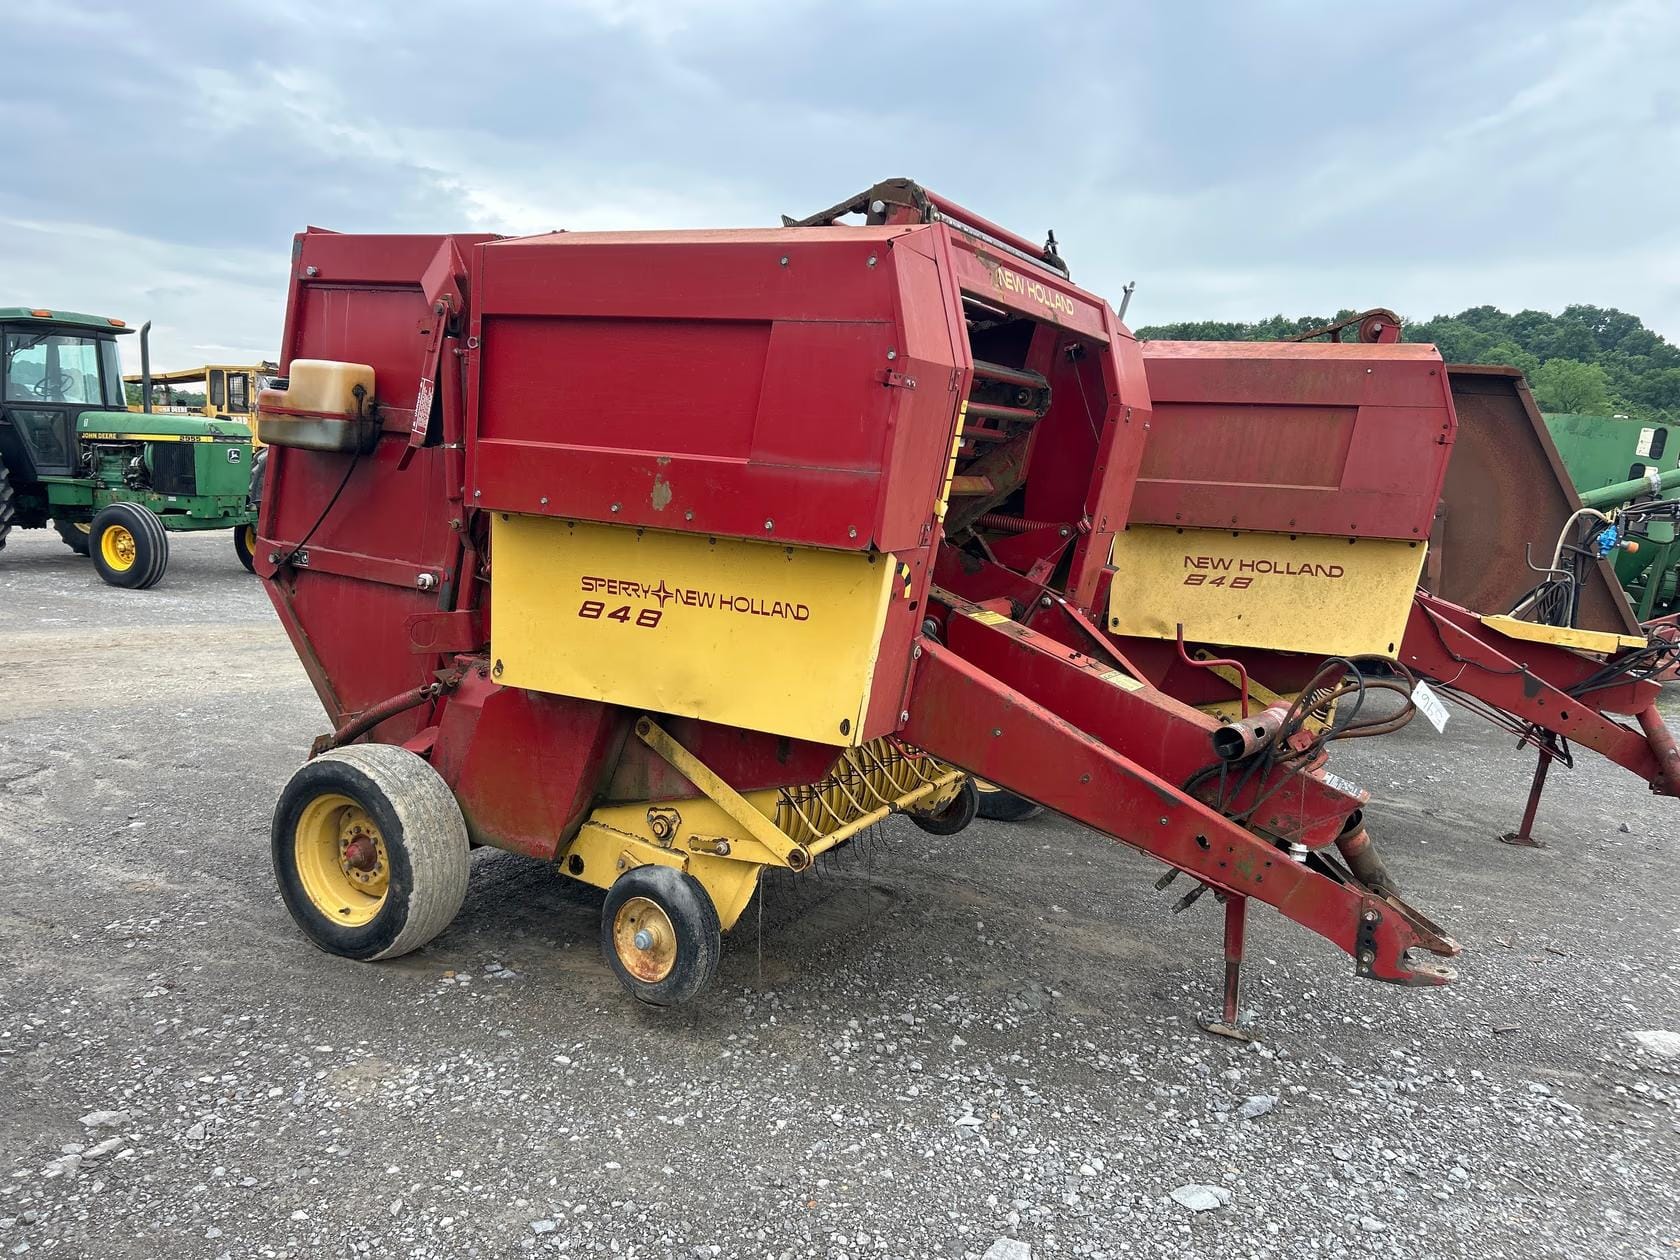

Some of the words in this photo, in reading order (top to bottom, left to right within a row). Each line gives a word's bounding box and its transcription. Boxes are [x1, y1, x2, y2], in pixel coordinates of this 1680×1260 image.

[997, 267, 1024, 294] NEW
[1027, 281, 1074, 315] HOLLAND
[97, 432, 117, 440] DEERE
[1183, 555, 1234, 571] NEW
[1239, 559, 1345, 578] HOLLAND
[1183, 573, 1254, 589] 848
[581, 576, 651, 600] SPERRY
[674, 588, 716, 609] NEW
[719, 594, 810, 621] HOLLAND
[578, 600, 663, 629] 848
